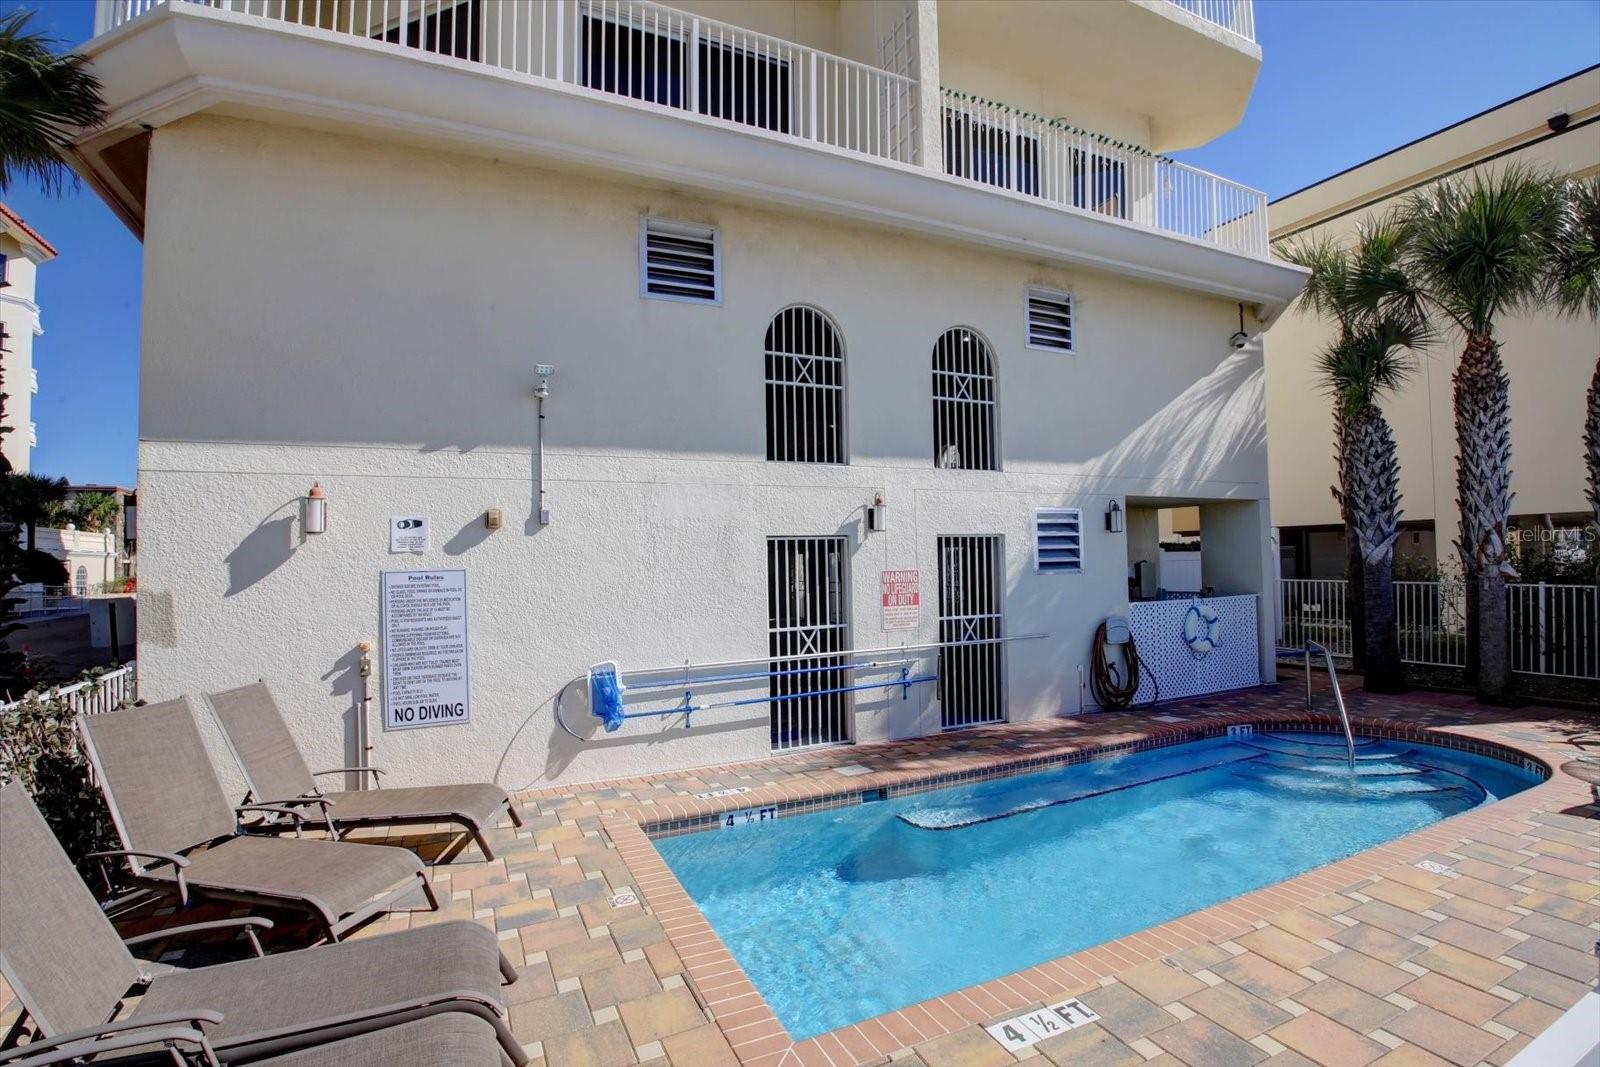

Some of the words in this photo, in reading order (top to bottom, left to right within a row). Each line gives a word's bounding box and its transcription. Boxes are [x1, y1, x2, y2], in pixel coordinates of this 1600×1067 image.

[882, 571, 919, 584] WARNING
[891, 583, 919, 595] LIFEGUARD
[888, 594, 897, 606] ON
[898, 594, 913, 606] DUTY
[394, 707, 415, 722] NO
[419, 702, 464, 720] DIVING
[1240, 726, 1251, 735] FT
[726, 814, 735, 826] 4
[760, 807, 776, 821] FT
[1002, 1024, 1026, 1042] 4
